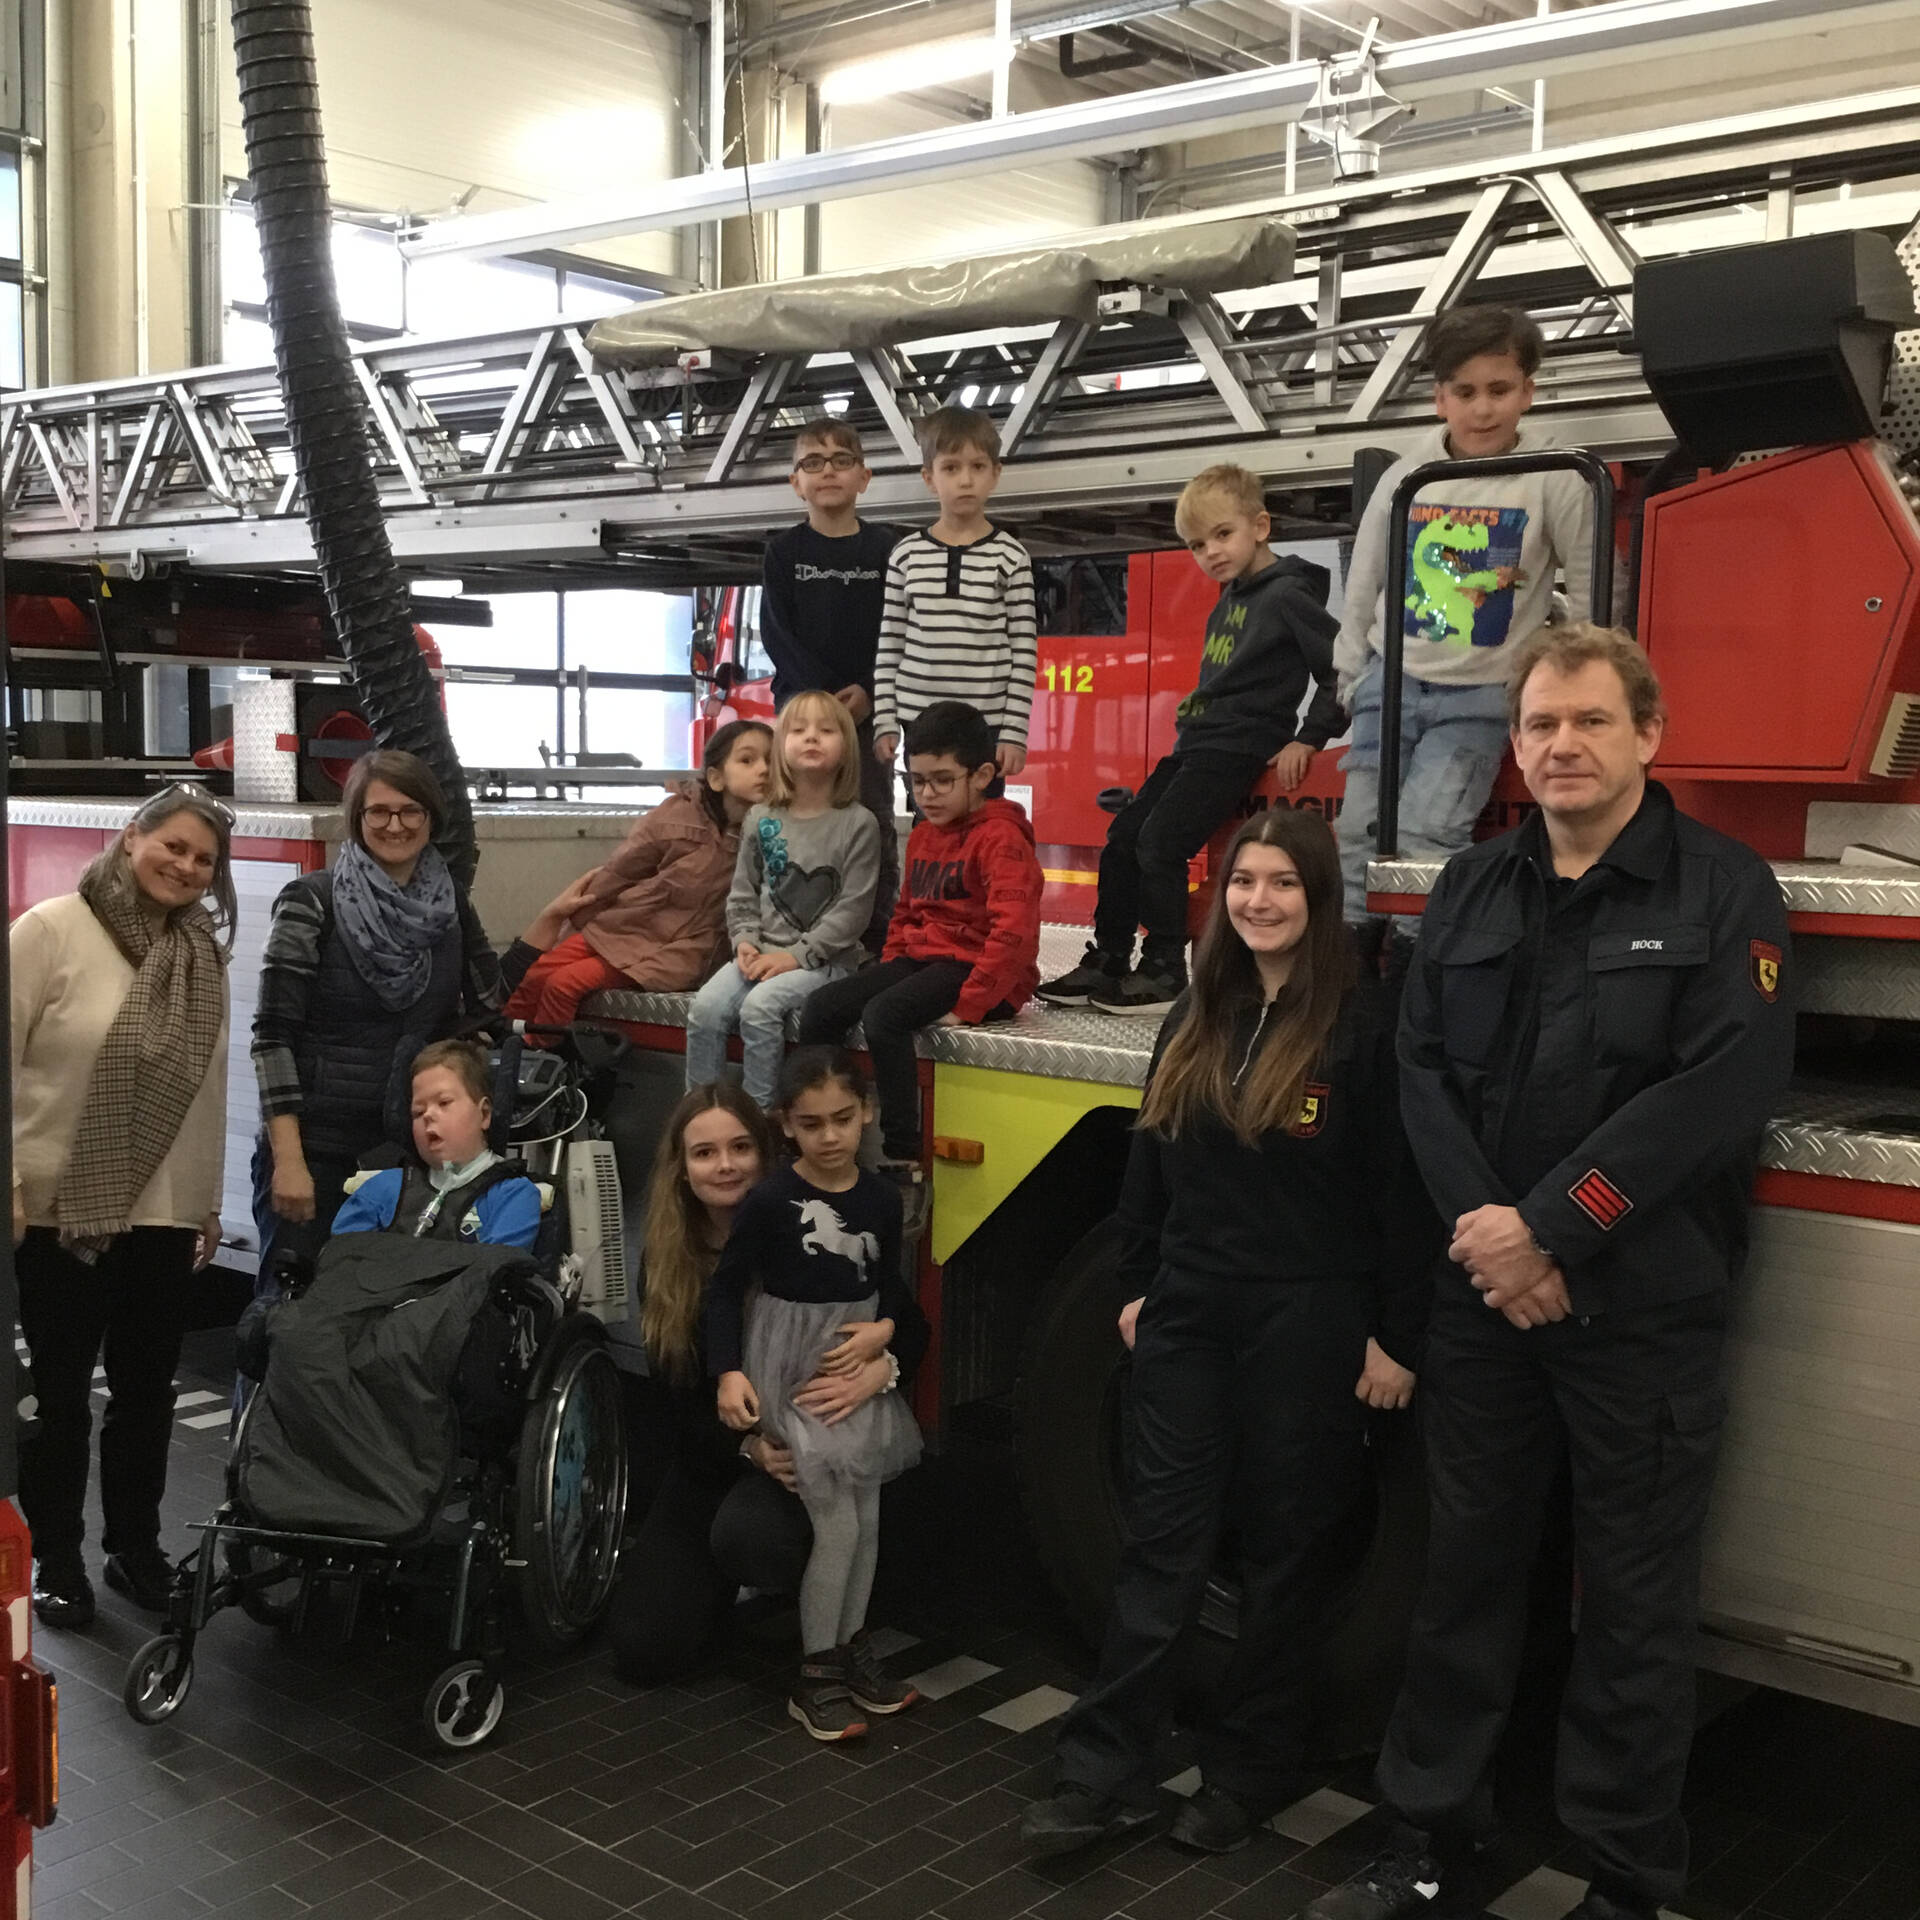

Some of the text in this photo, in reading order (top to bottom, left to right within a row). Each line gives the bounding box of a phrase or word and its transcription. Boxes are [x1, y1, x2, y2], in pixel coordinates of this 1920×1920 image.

[795, 564, 880, 585] Champion
[1044, 665, 1093, 692] 112
[1631, 940, 1664, 950] HOCK
